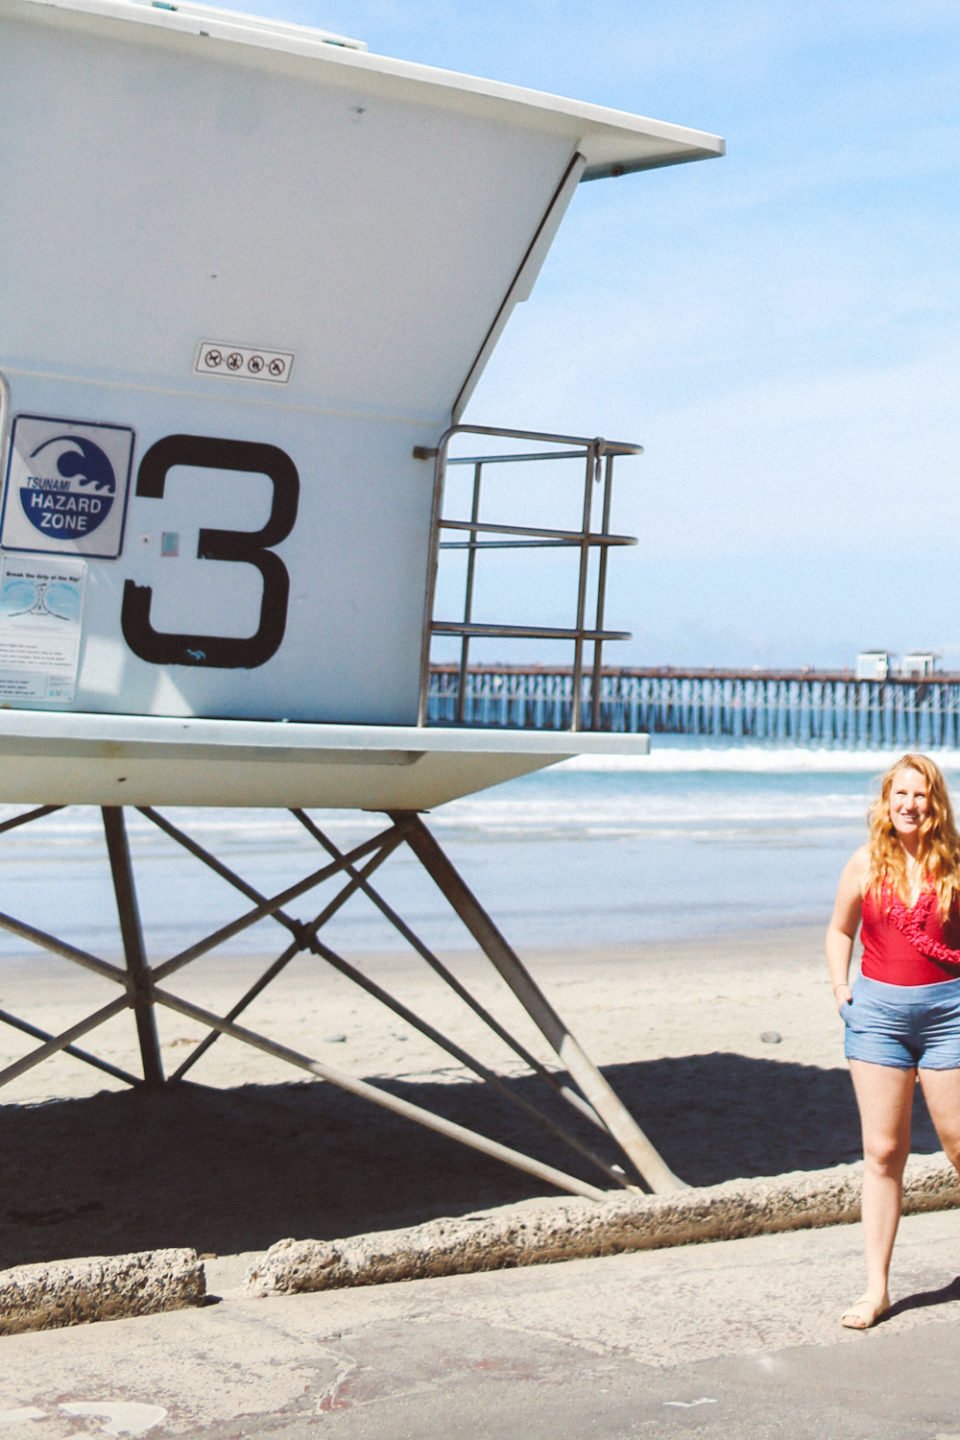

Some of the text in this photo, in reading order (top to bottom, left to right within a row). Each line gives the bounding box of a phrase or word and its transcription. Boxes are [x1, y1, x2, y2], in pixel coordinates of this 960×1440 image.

[27, 476, 71, 492] TSUNAMI
[31, 492, 102, 514] HAZARD
[40, 512, 88, 531] ZONE
[121, 434, 300, 670] 3
